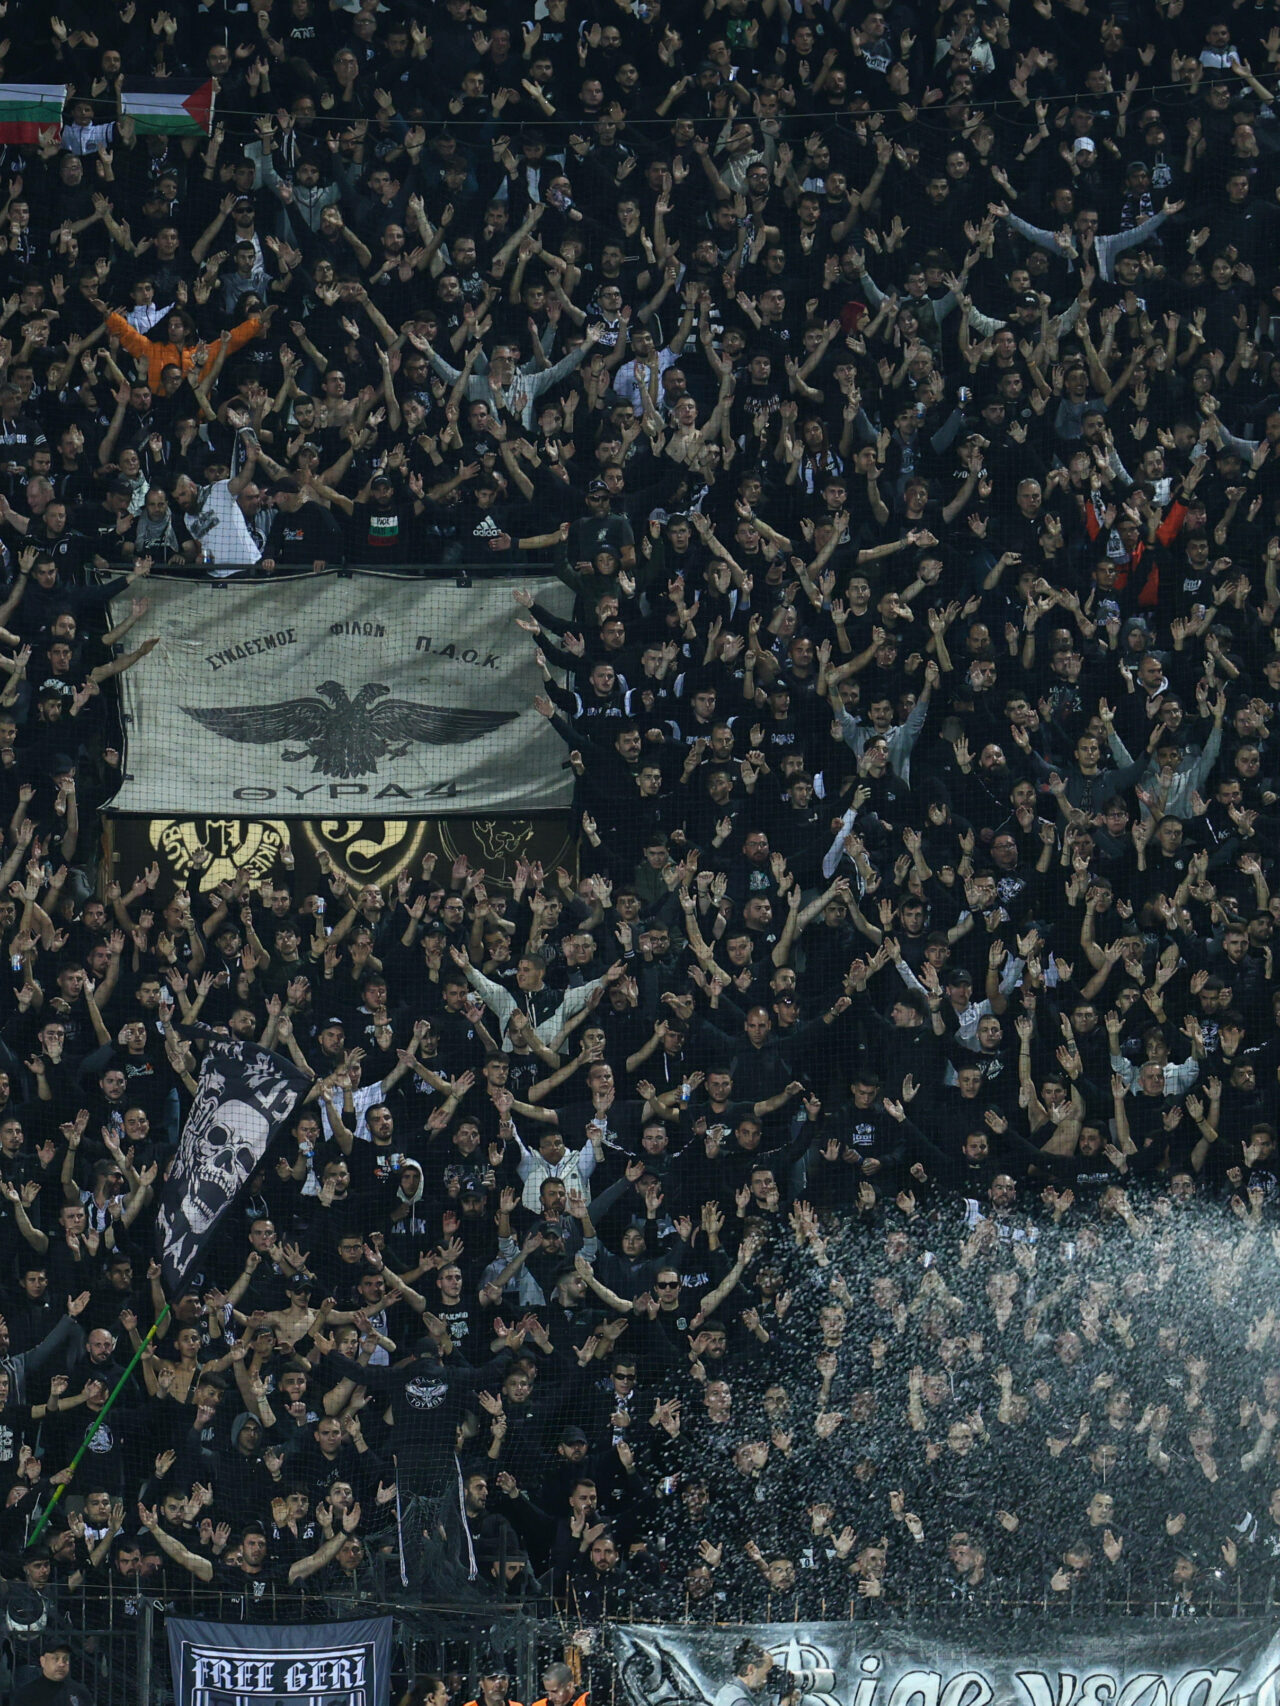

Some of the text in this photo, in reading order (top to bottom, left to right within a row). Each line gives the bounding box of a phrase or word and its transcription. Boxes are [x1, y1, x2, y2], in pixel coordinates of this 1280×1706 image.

[205, 628, 297, 672] ΣΥΝΔΕΣΜΟΣ
[330, 621, 385, 638] ΦΙΛΩΝ
[410, 1396, 444, 1409] ΤΟΥΜΠΑ
[191, 1654, 367, 1692] FREE GERI
